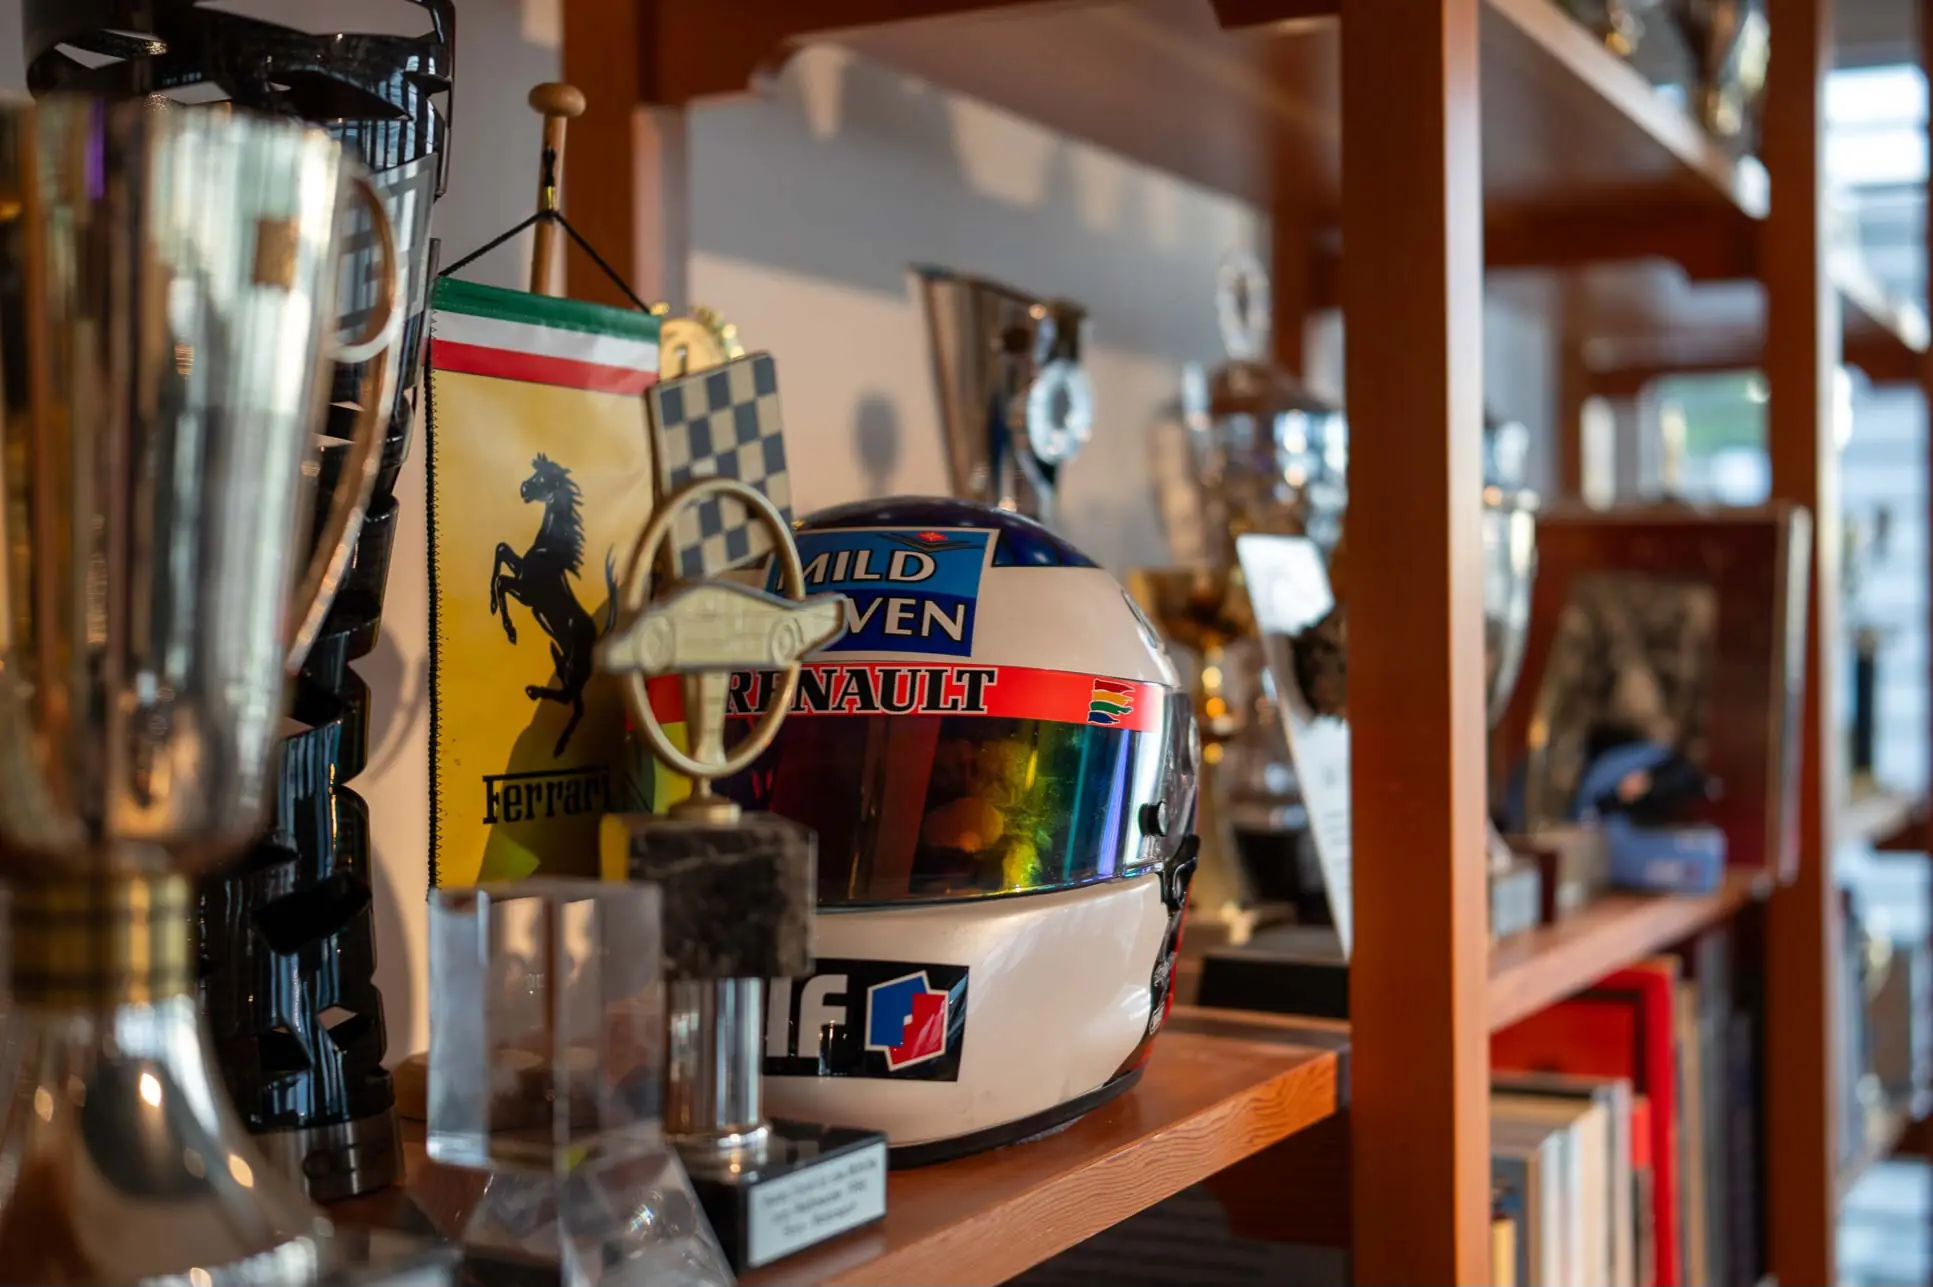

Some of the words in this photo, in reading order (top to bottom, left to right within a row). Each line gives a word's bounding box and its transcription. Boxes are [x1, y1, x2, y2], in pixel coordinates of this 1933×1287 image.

[776, 549, 937, 592] MILD
[847, 596, 965, 642] VEN
[724, 667, 998, 714] RENAULT
[482, 766, 611, 824] Ferrari
[765, 973, 848, 1059] lf
